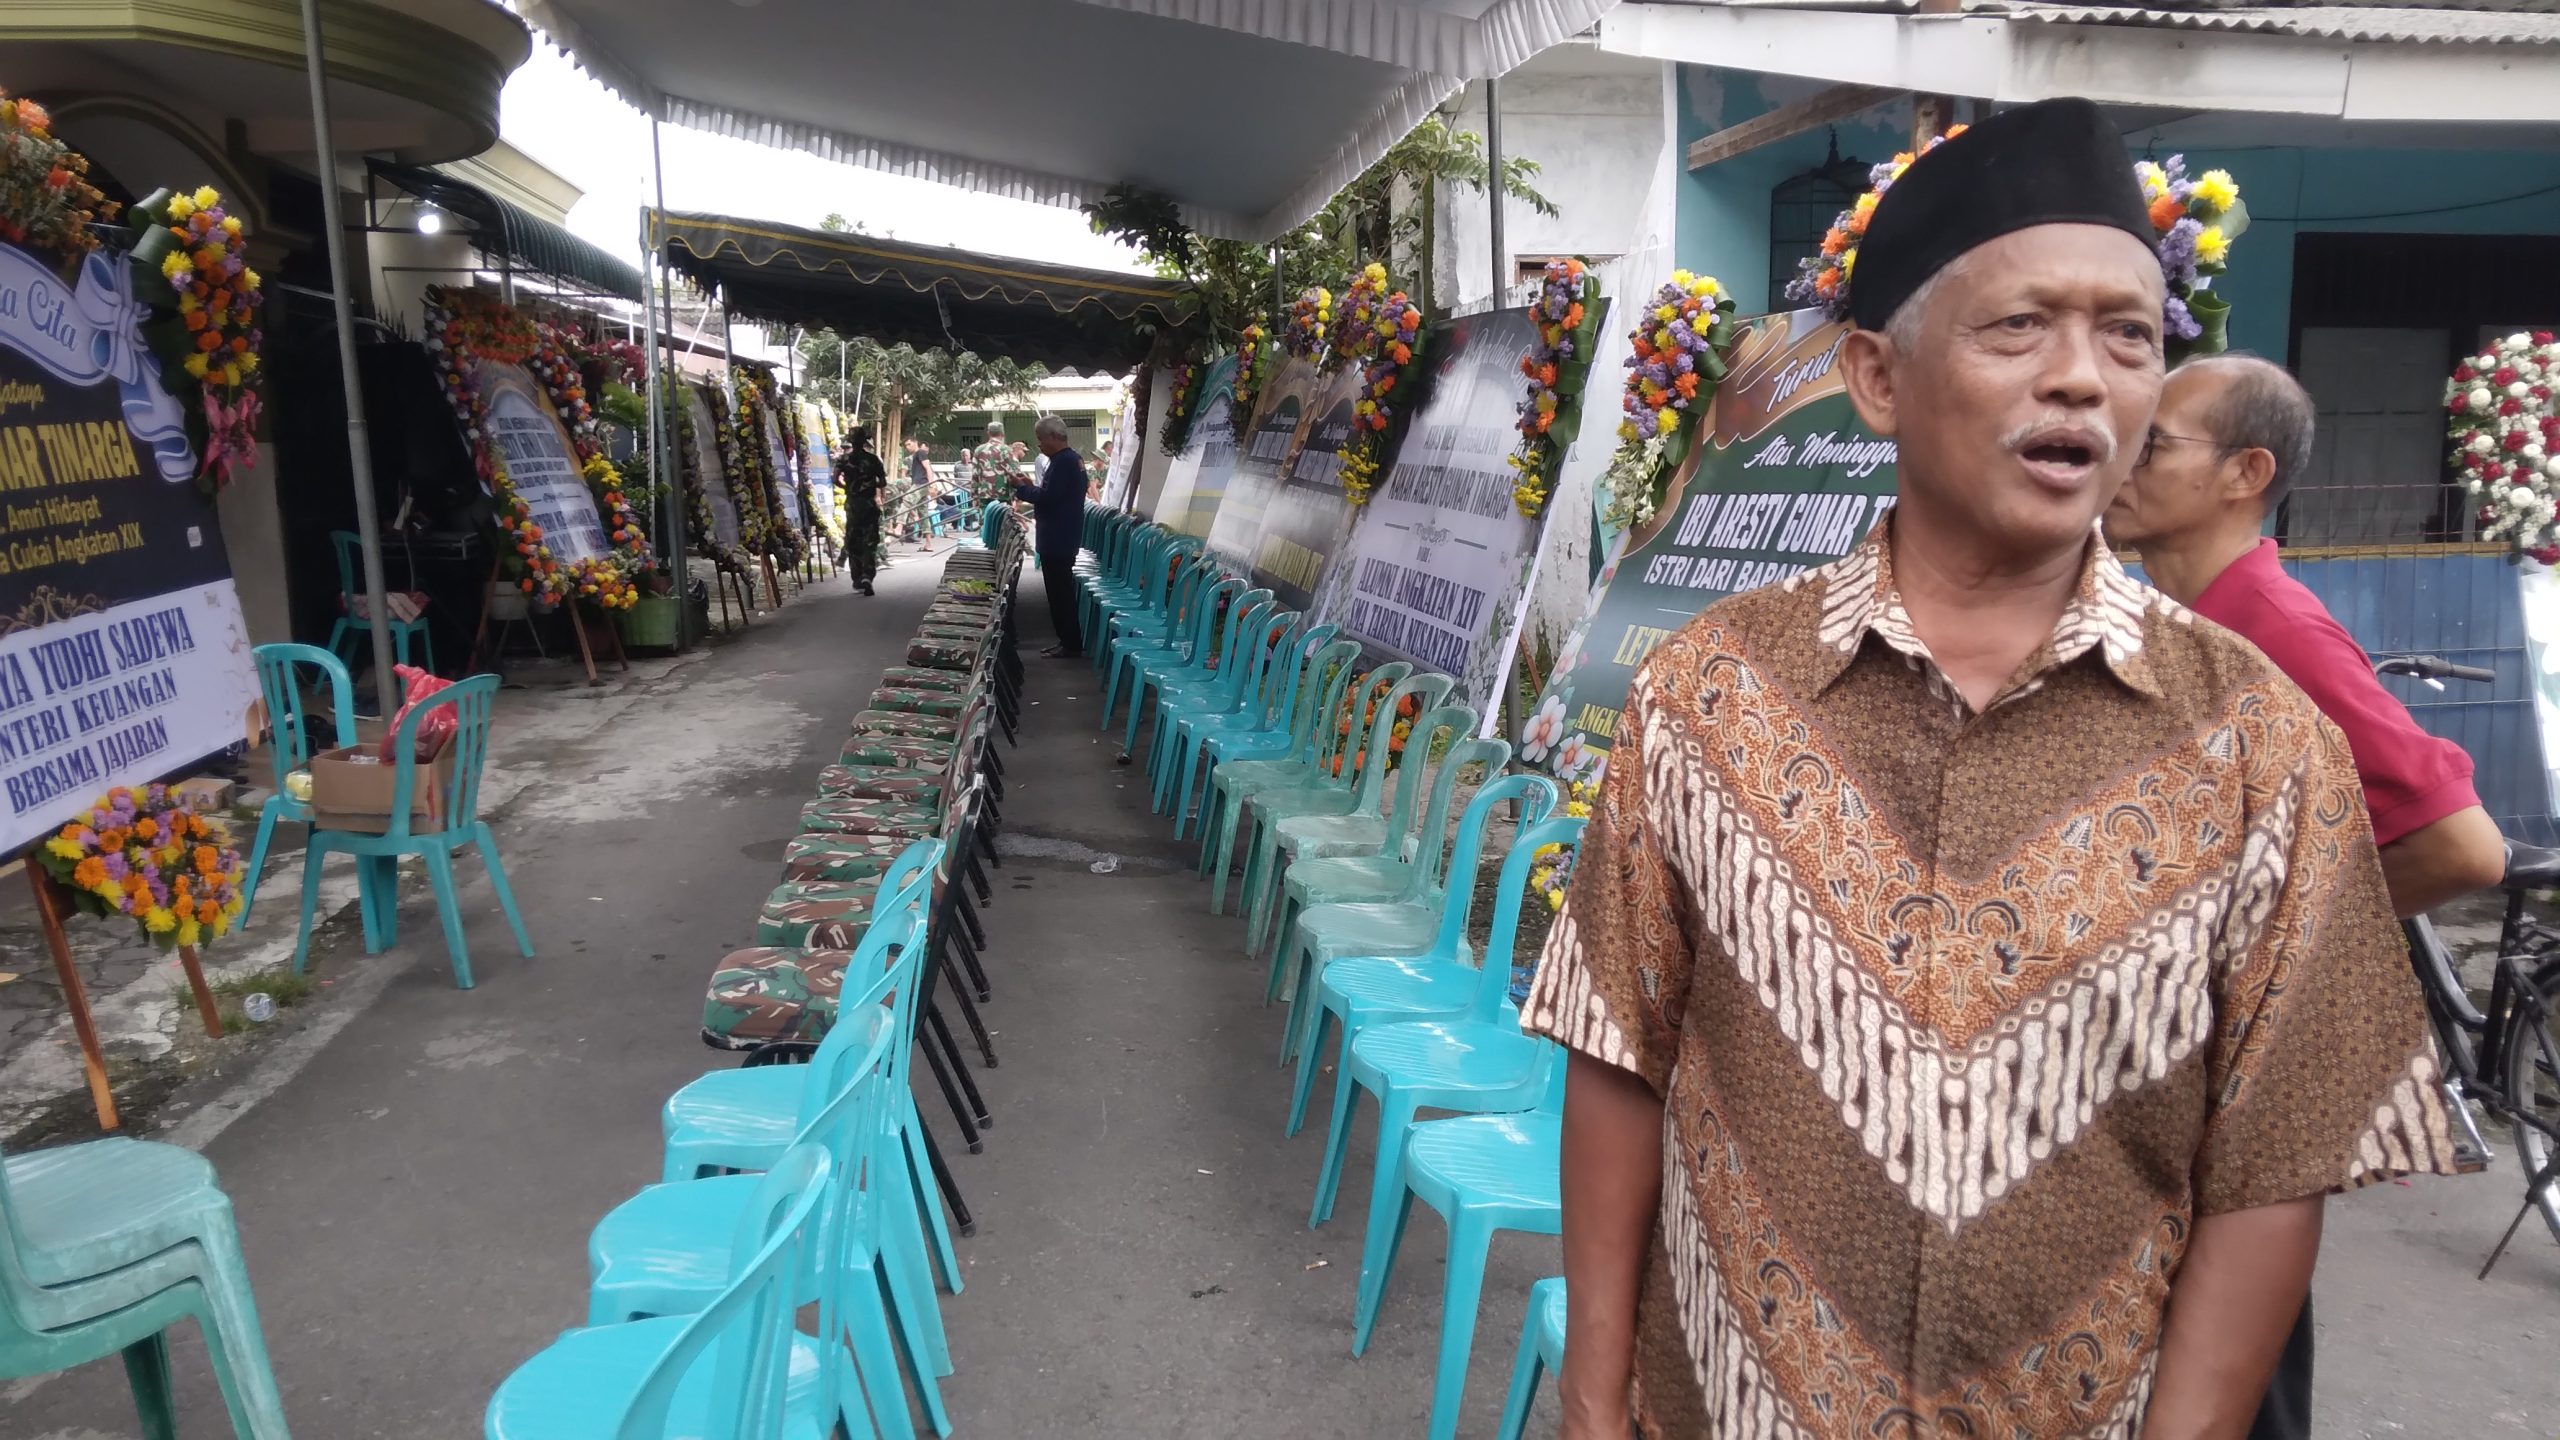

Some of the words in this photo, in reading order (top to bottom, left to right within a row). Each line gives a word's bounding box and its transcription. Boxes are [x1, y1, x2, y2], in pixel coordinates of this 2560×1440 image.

[0, 283, 19, 319] a
[27, 279, 78, 352] Cita
[1766, 329, 1849, 413] Turut
[0, 426, 48, 491] NAR
[36, 420, 141, 484] TINARGA
[1744, 434, 1796, 469] Atas
[1796, 431, 1898, 478] Meningga
[10, 536, 55, 570] Cukai
[55, 529, 121, 564] Angkatan
[118, 521, 145, 549] XIX
[44, 494, 102, 527] Hidayat
[1673, 494, 1722, 547] IBU
[1705, 493, 1792, 550] ARESTY
[1776, 493, 1869, 556] GUNAR
[1864, 495, 1898, 538] T
[1357, 557, 1401, 600] ALUMNI
[1393, 567, 1461, 622] ANGKATAN
[1453, 585, 1486, 632] XIV
[1643, 555, 1695, 587] ISTRI
[1688, 557, 1738, 592] DARI
[0, 653, 34, 712] YA
[28, 629, 111, 696] YUDHI
[107, 606, 196, 671] SADEWA
[1366, 604, 1407, 650] TARUNA
[1403, 617, 1470, 679] NUSANTARA
[1612, 624, 1681, 667] LET
[0, 704, 71, 766] NTERI
[71, 666, 178, 734] KEUANGAN
[4, 745, 99, 815] BERSAMA
[96, 714, 169, 778] JAJARAN
